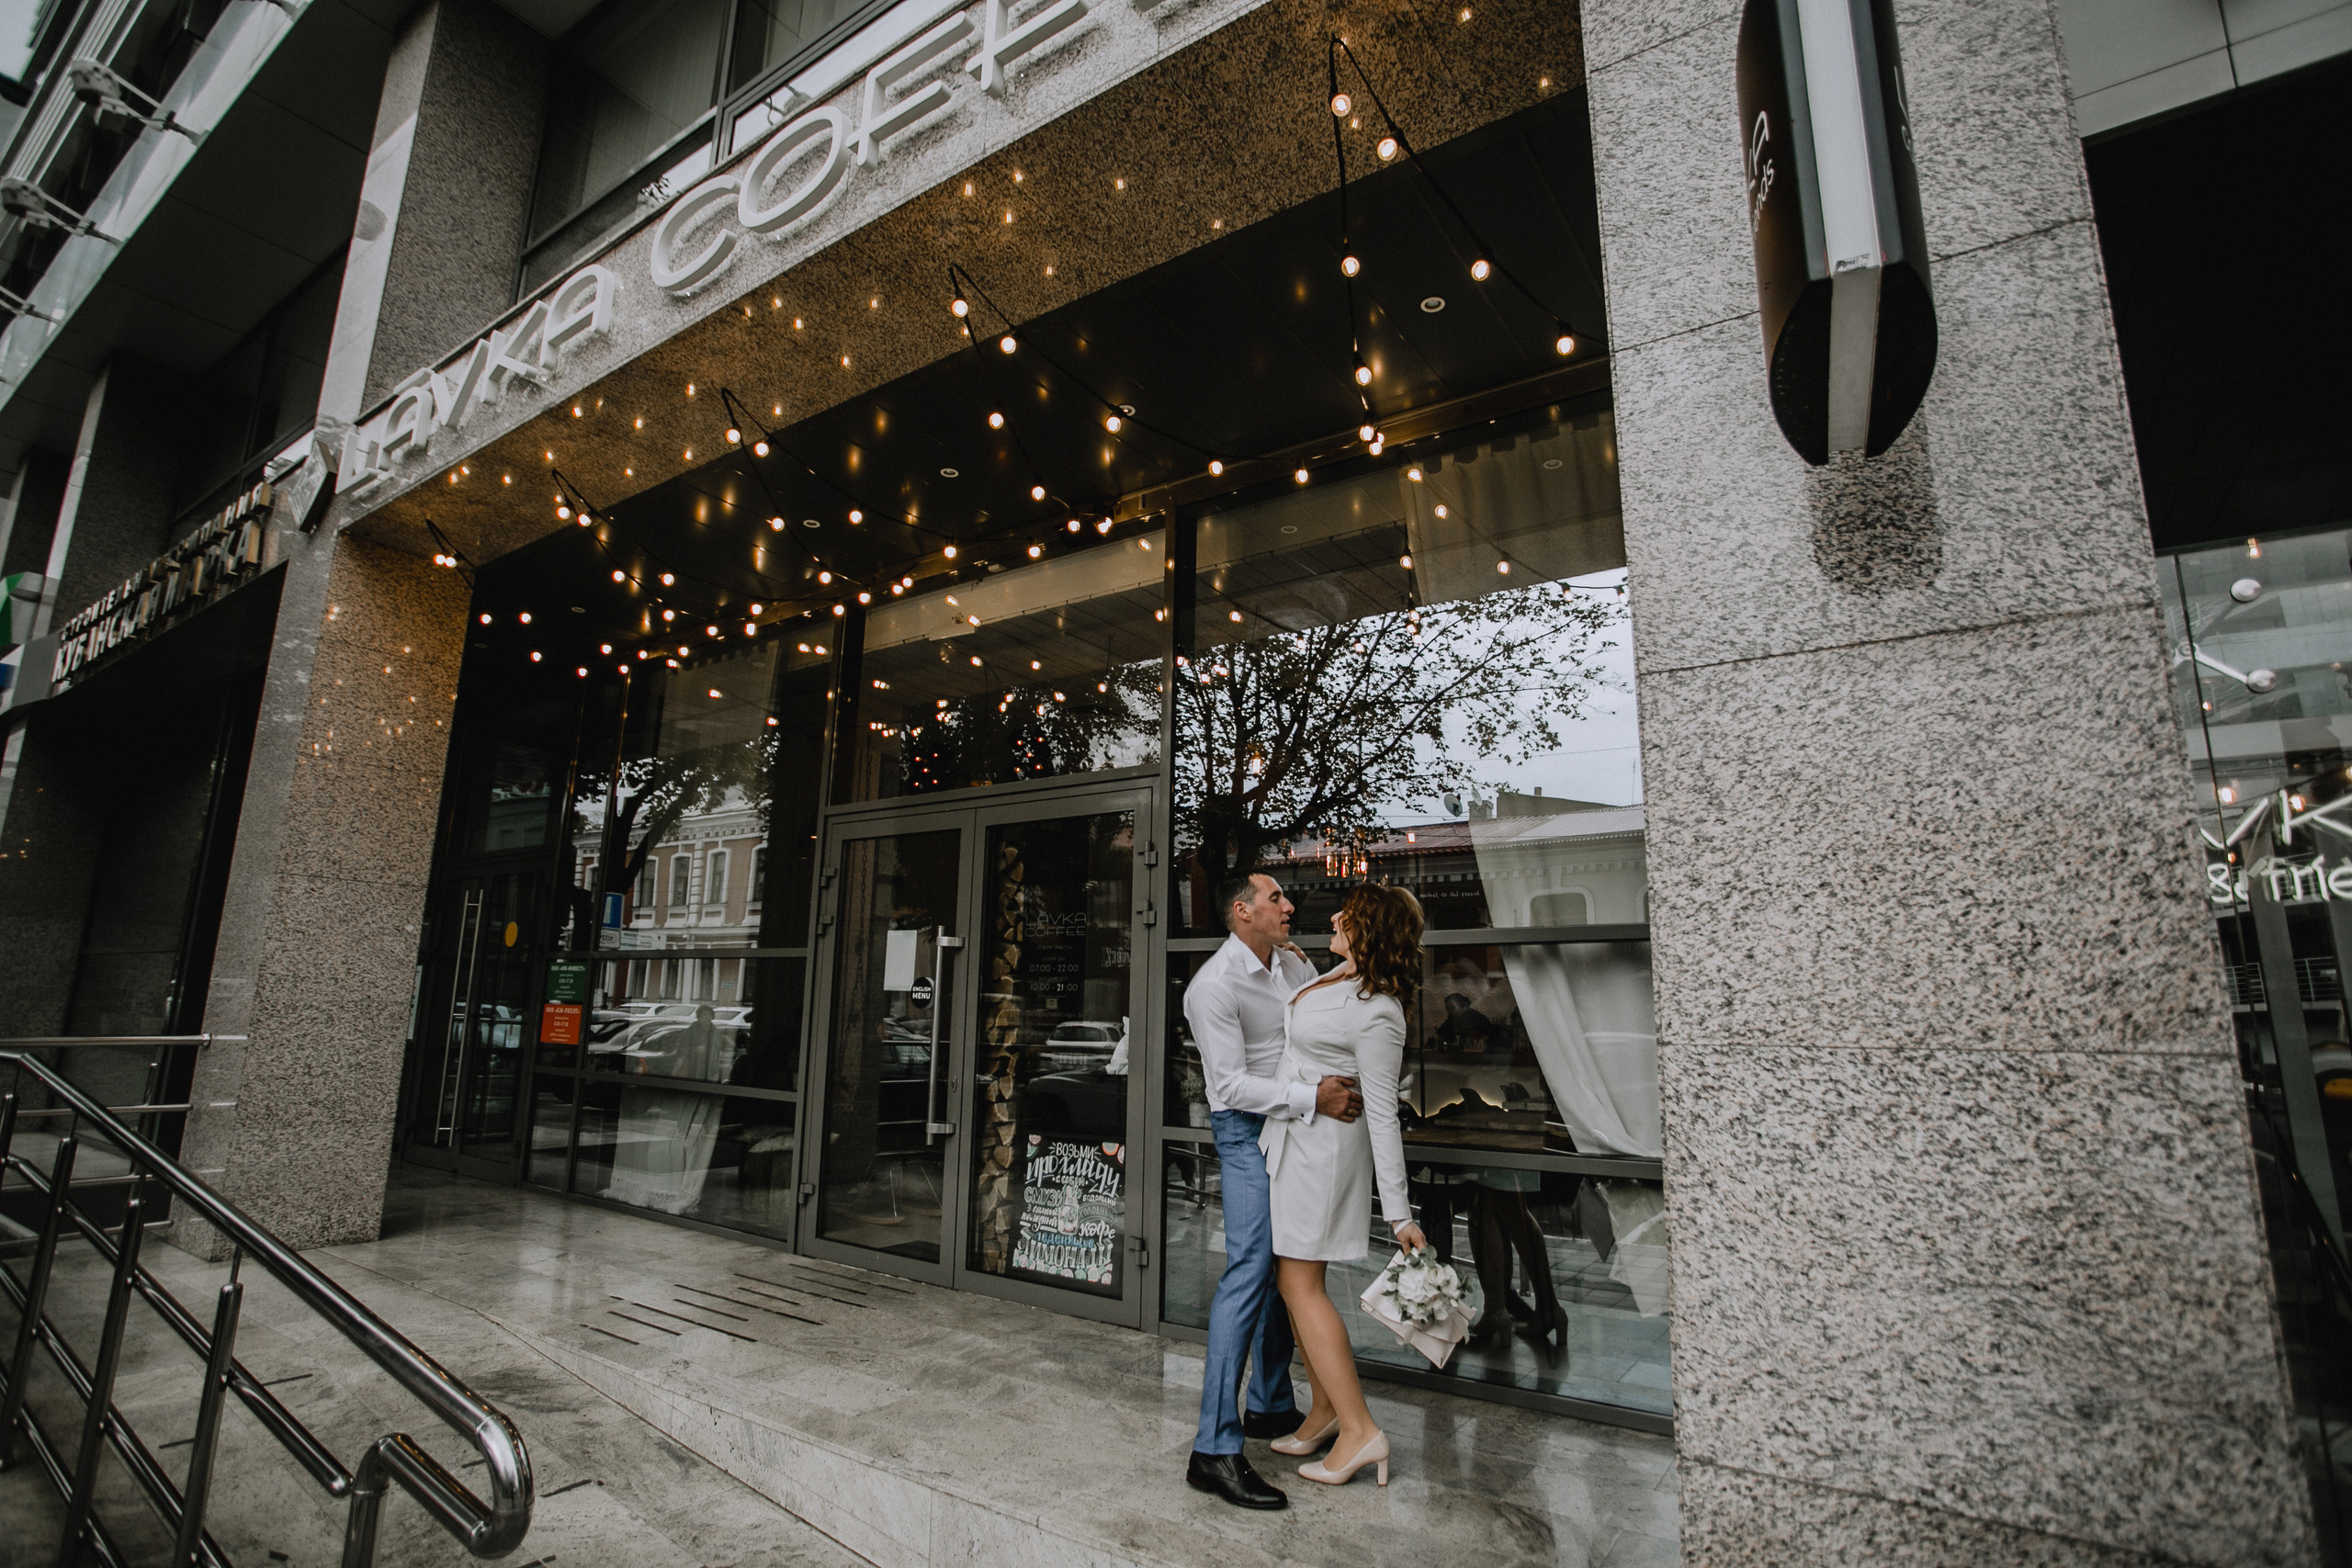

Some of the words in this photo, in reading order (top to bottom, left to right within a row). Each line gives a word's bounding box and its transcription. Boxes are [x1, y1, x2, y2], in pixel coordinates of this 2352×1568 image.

[650, 0, 1178, 296] COFF
[1024, 925, 1086, 937] COFFEE
[1056, 1142, 1095, 1159] ВОЗЬМИ
[1018, 1239, 1114, 1269] ЛИМОНАДЫ
